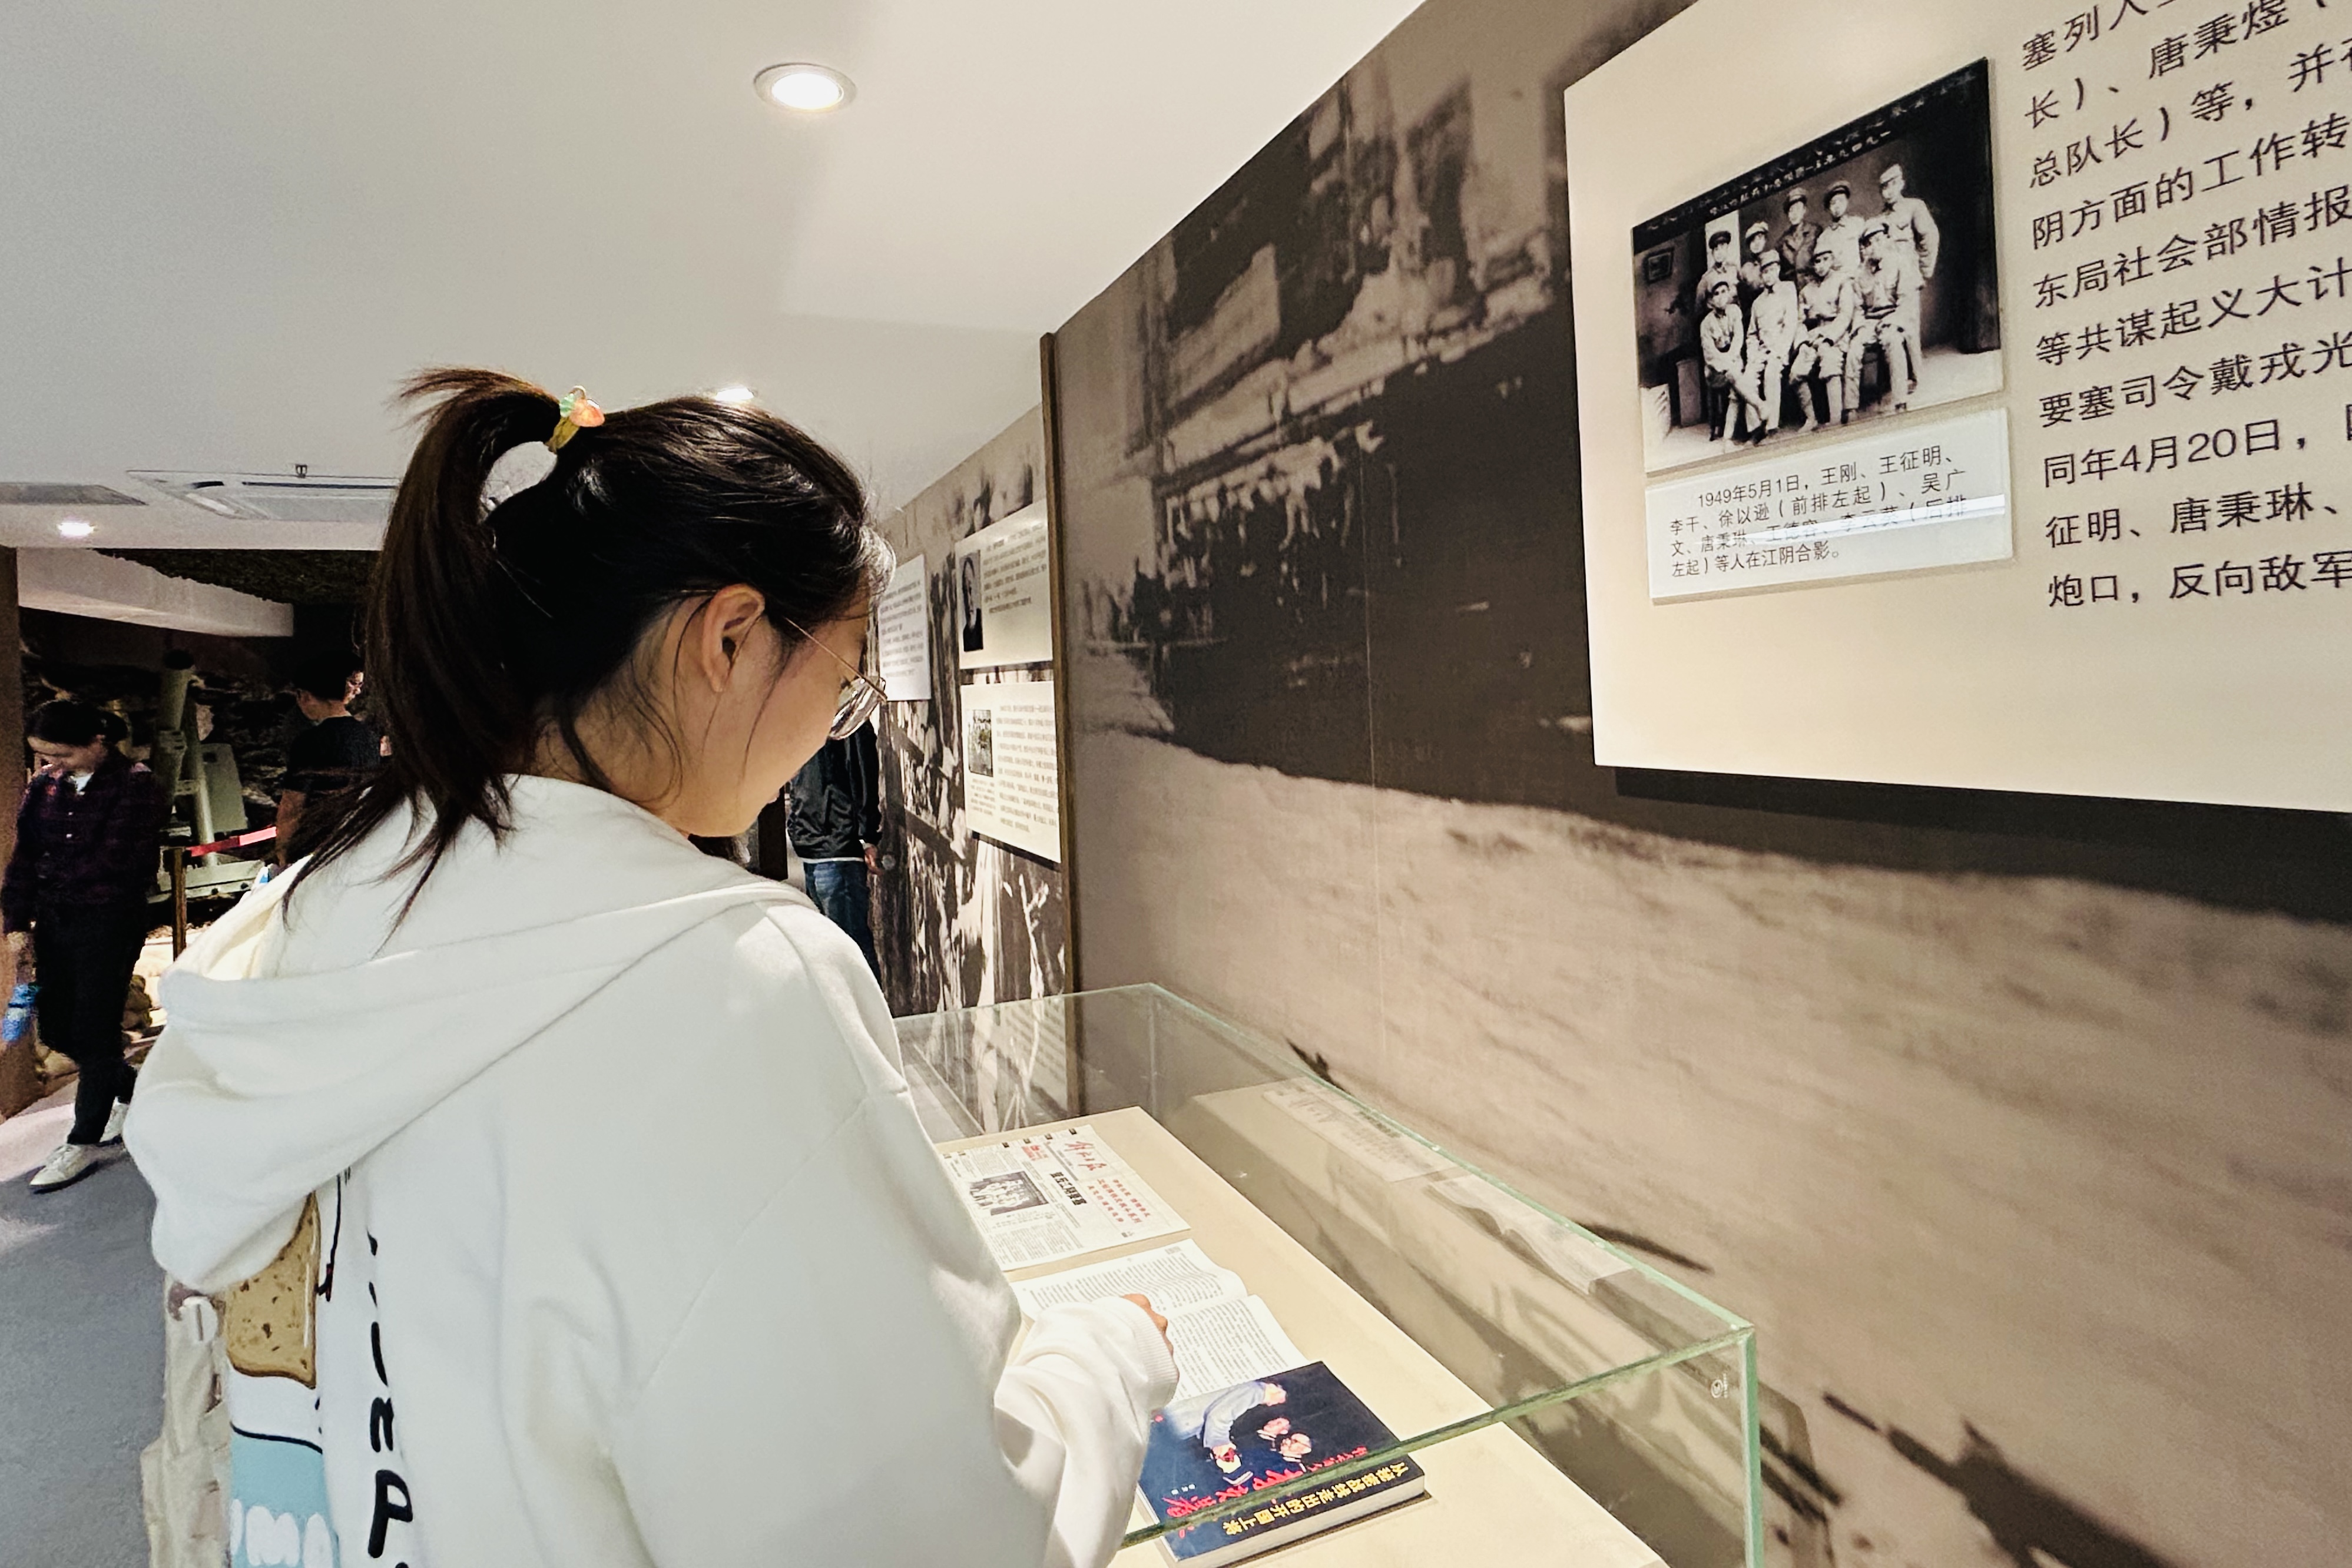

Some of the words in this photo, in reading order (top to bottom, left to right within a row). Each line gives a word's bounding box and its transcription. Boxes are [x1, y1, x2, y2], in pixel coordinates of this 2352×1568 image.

[2022, 0, 2175, 71] 塞列人
[2024, 0, 2327, 129] 长）、唐秉煜
[2032, 112, 2350, 250] 阴方面的工作转
[2033, 184, 2352, 308] 东局社会部情报
[2036, 257, 2352, 366] 等共谋起义大计
[2039, 331, 2352, 427] 要塞司令戴戎光
[1698, 445, 1953, 507] 1949年5月1日，王刚、王征明、
[2044, 403, 2352, 488] 同年4月20日，
[2045, 482, 2337, 548] 征明、唐秉琳、
[1672, 540, 1840, 578] 左起）等人在江阴合影。
[2049, 551, 2352, 607] 炮口，反向敌军
